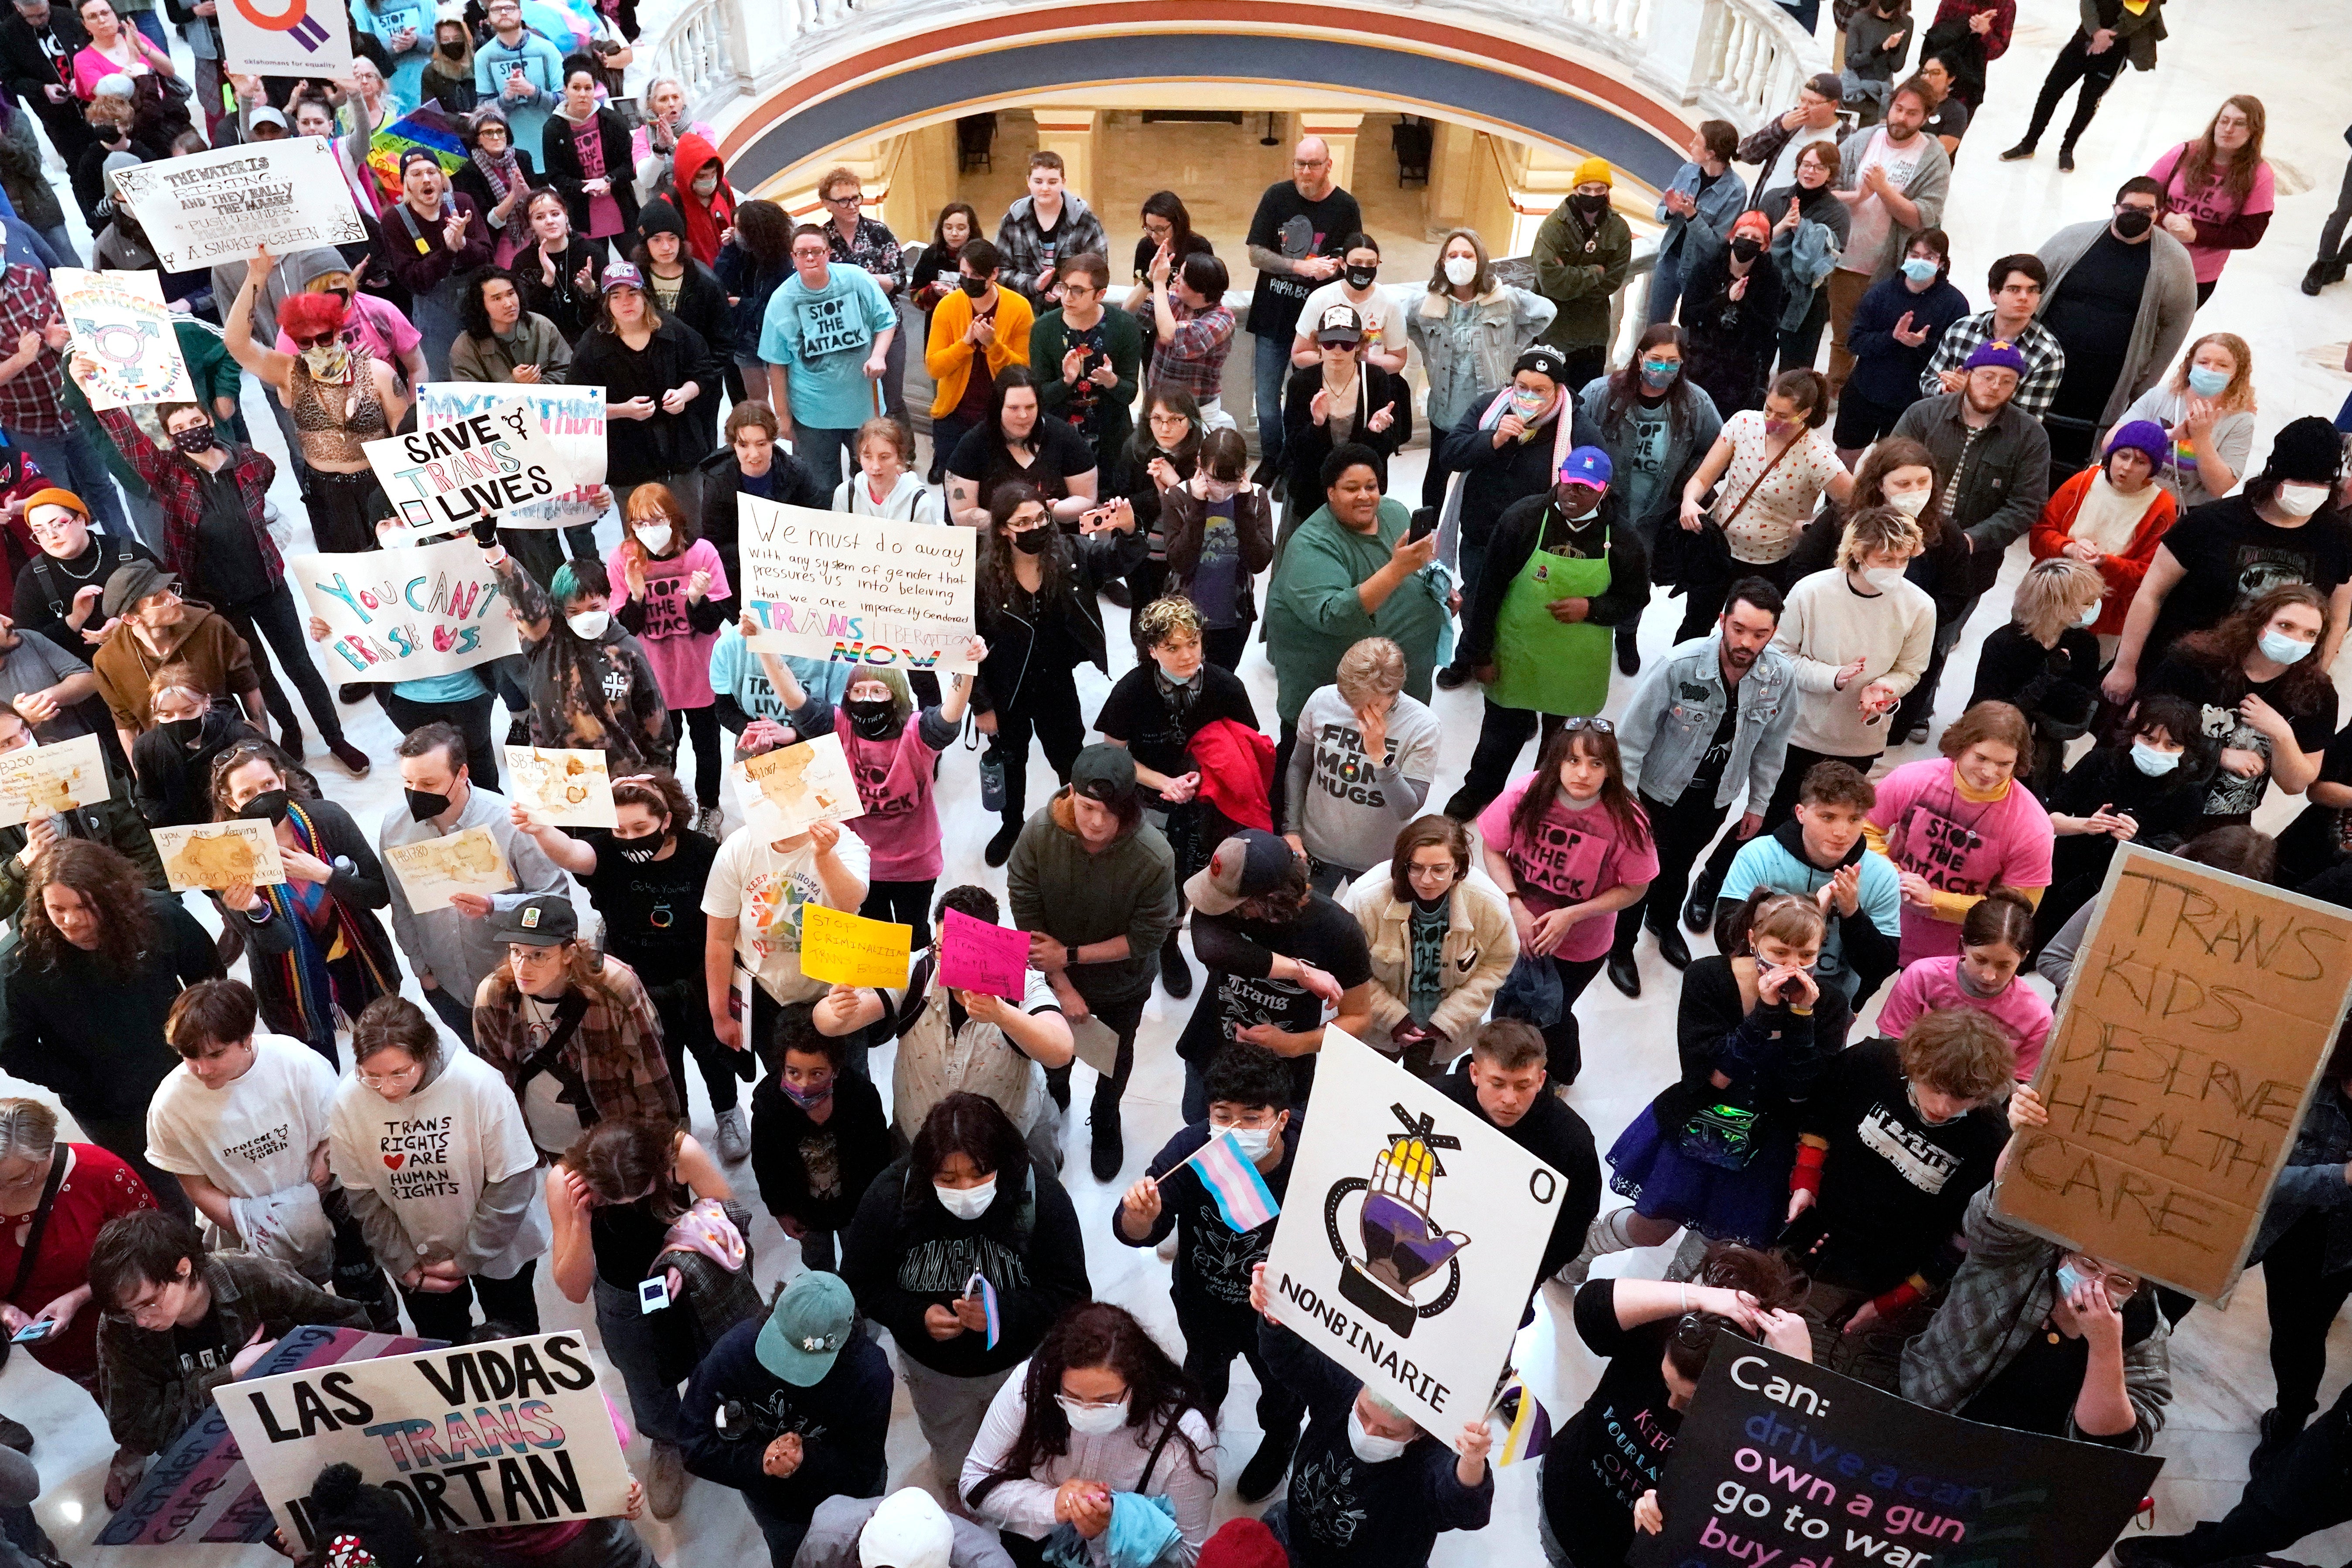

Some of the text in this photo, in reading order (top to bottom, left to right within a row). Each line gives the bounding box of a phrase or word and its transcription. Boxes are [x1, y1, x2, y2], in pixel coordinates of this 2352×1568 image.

[378, 13, 405, 28] STOP
[576, 133, 598, 149] TOP
[164, 157, 269, 188] THE WATER IS
[181, 182, 293, 210] AND THEY RALLY
[212, 203, 242, 215] THE
[188, 216, 228, 230] PUSH
[231, 212, 249, 223] US
[187, 245, 201, 260] A
[83, 274, 125, 292] ONE
[1269, 278, 1294, 297] PAPA
[63, 290, 167, 322] STRUGGLE
[809, 299, 845, 318] STOP
[817, 316, 845, 332] THE
[806, 330, 865, 354] ATTACK
[134, 351, 182, 401] Together
[426, 393, 481, 429] MY
[404, 414, 501, 464] SAVE
[393, 440, 521, 498] TRANS
[435, 465, 552, 523] LIVES
[750, 502, 964, 567] We must do away
[753, 565, 816, 584] pressures
[858, 578, 889, 593] into
[899, 579, 954, 605] beleiving
[789, 554, 810, 569] any
[815, 558, 855, 576] system
[861, 564, 881, 575] of
[886, 566, 934, 583] gender
[937, 571, 967, 585] that
[315, 571, 498, 624] YOU CAN'T
[644, 579, 681, 598] TOP
[754, 585, 780, 600] that
[789, 594, 808, 604] we
[819, 597, 847, 609] are
[860, 602, 921, 621] imperfectly
[645, 598, 676, 617] THE
[750, 600, 976, 647] TRANS LIBERATION
[333, 623, 482, 672] ERASE US.
[829, 641, 941, 668] NOW
[1317, 770, 1386, 808] HUGS
[160, 825, 258, 847] you are leaving
[1925, 818, 1983, 853] STOP
[392, 845, 429, 864] HB1780
[1531, 842, 1568, 870] THE
[1927, 842, 1966, 873] THE
[172, 871, 192, 882] on
[199, 870, 220, 881] our
[746, 870, 821, 896] KEEP OKLAHOMA
[1513, 852, 1585, 897] ATTACK
[812, 914, 858, 934] STOP
[2122, 869, 2347, 982] TRANS
[808, 948, 852, 965] TRANS
[856, 963, 907, 976] BODIES
[1227, 973, 1290, 1011] Trans
[2095, 943, 2256, 1033] KIDS
[2059, 1002, 2304, 1129] DESERVE
[383, 1116, 452, 1135] TRANS
[2044, 1074, 2267, 1191] HEALTH
[223, 1132, 272, 1158] protect
[242, 1138, 276, 1159] trans
[250, 1141, 289, 1164] youth
[380, 1132, 450, 1153] RIGHTS
[409, 1149, 447, 1167] ARE
[390, 1168, 450, 1191] HUMAN
[390, 1182, 460, 1200] RIGHTS
[2020, 1134, 2231, 1254] CARE
[1278, 1273, 1451, 1415] NONBINARIE
[247, 1335, 597, 1443] LAS VIDAS
[1729, 1354, 1831, 1418] Can:
[363, 1399, 566, 1472] TRANS
[1603, 1405, 1637, 1460] YOUR
[1633, 1408, 1676, 1452] KEEP
[1591, 1459, 1616, 1488] MY
[1603, 1454, 1643, 1492] OFF
[1744, 1412, 1974, 1507] drive a car
[102, 1439, 209, 1545] Gender
[284, 1449, 588, 1552] IORTAN
[1734, 1446, 1965, 1544] own a gun
[1715, 1479, 1932, 1568] go to war
[1698, 1517, 1782, 1568] buy
